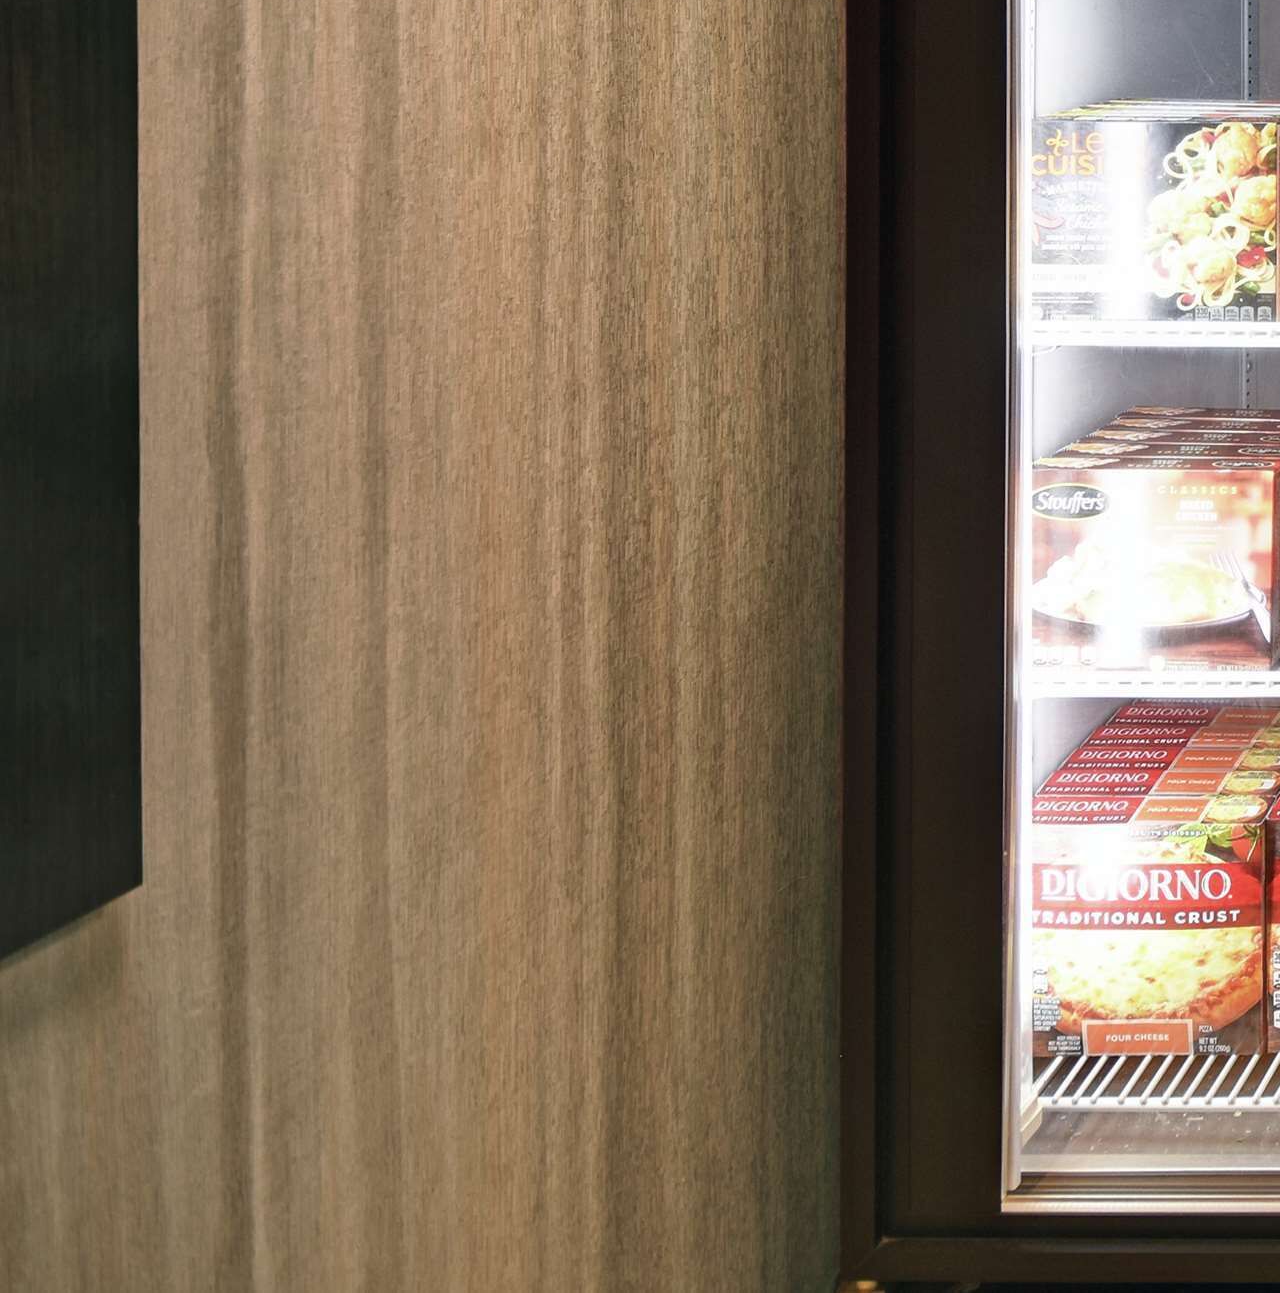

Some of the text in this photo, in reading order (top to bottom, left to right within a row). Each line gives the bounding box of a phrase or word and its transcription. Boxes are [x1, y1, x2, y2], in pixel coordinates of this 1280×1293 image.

[1036, 491, 1105, 514] Stouffer's
[1126, 707, 1209, 717] DIGIORNO
[1101, 726, 1187, 736] DIGIORNO
[1078, 750, 1169, 760] DIGIORNO
[1055, 773, 1149, 783] DIGIORNO
[1036, 801, 1129, 812] DIGIORNO
[1040, 868, 1232, 903] DIGIORNO
[1032, 909, 1241, 925] TRADITIONAL CRUST
[1105, 1033, 1169, 1042] FOUR CHEESE
